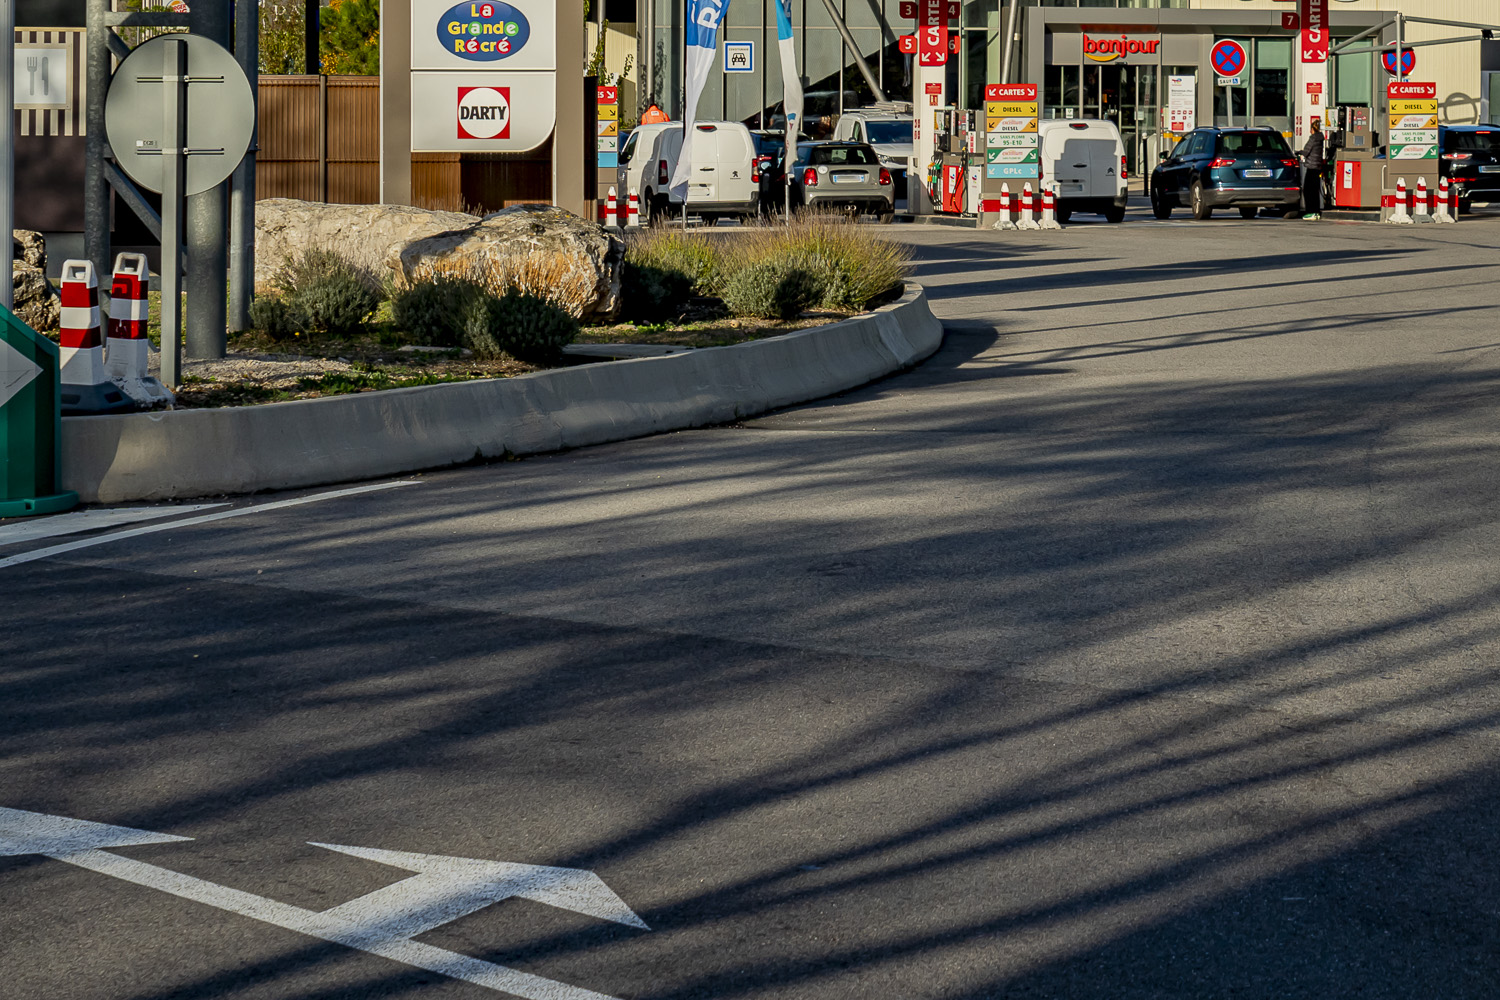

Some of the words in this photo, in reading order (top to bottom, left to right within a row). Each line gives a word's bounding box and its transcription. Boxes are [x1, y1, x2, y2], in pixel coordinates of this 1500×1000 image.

[471, 3, 492, 18] La
[905, 5, 912, 15] 3
[1287, 16, 1294, 25] 7
[447, 21, 516, 35] Grande
[454, 36, 510, 53] Récré
[905, 39, 912, 50] 5
[1083, 34, 1160, 58] bonjour
[998, 88, 1025, 96] CARTES
[1400, 86, 1425, 94] CARTES
[460, 106, 507, 120] DARTY
